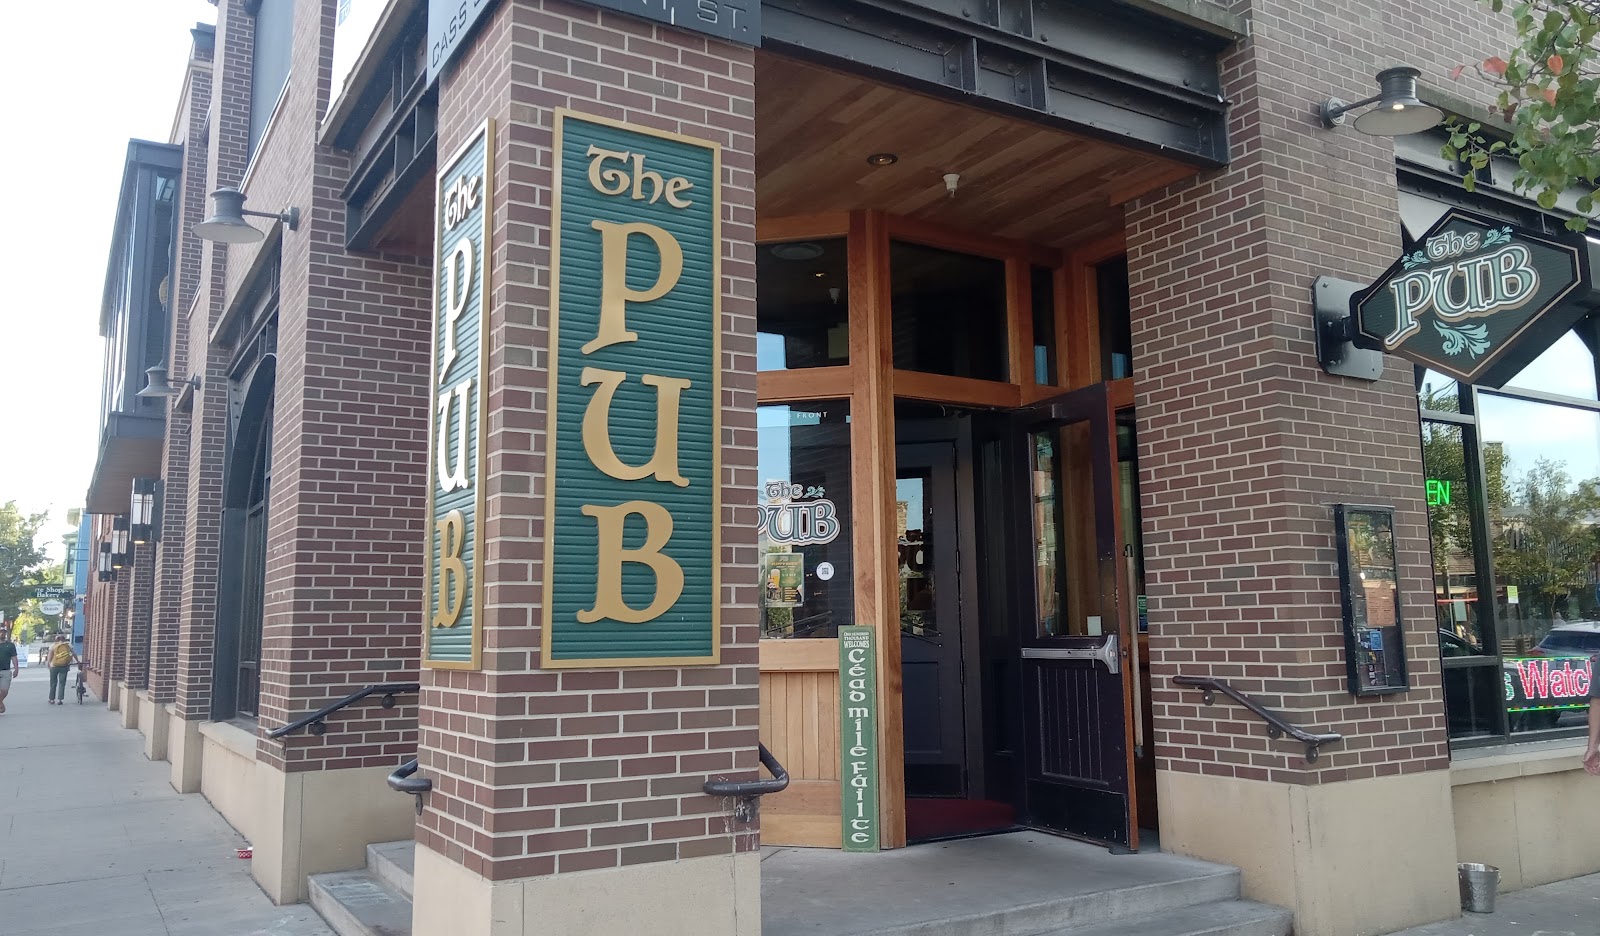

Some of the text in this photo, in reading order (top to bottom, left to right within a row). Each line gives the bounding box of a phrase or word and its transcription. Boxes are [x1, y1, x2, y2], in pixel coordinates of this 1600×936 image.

[432, 1, 467, 69] CASS
[696, 0, 749, 32] ST.
[586, 144, 694, 209] The
[443, 174, 480, 232] The
[1426, 231, 1480, 261] The
[1384, 243, 1541, 350] PUB
[432, 237, 474, 628] PUB
[577, 219, 691, 624] PUB
[796, 411, 828, 419] FRONT
[765, 481, 804, 500] The
[1426, 480, 1450, 505] EN
[843, 640, 870, 648] WELCOMES
